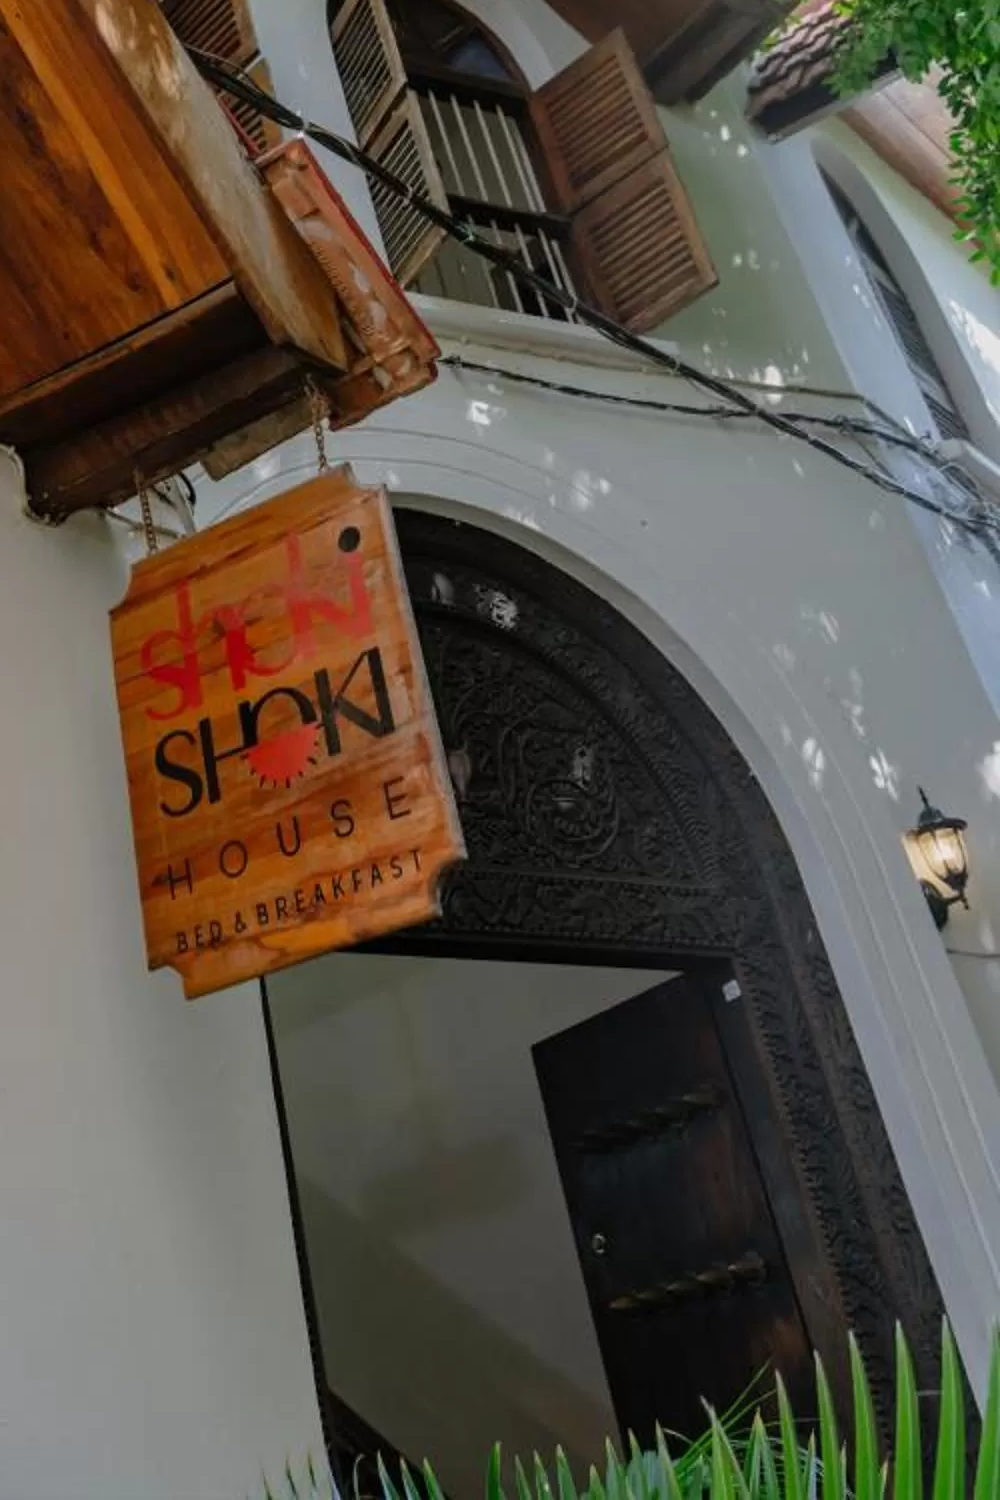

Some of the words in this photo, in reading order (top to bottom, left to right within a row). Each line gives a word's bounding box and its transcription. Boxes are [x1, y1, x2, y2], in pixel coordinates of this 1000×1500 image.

[167, 776, 412, 900] HOUSE
[176, 920, 222, 954] BED
[255, 849, 422, 926] BREAKFAST
